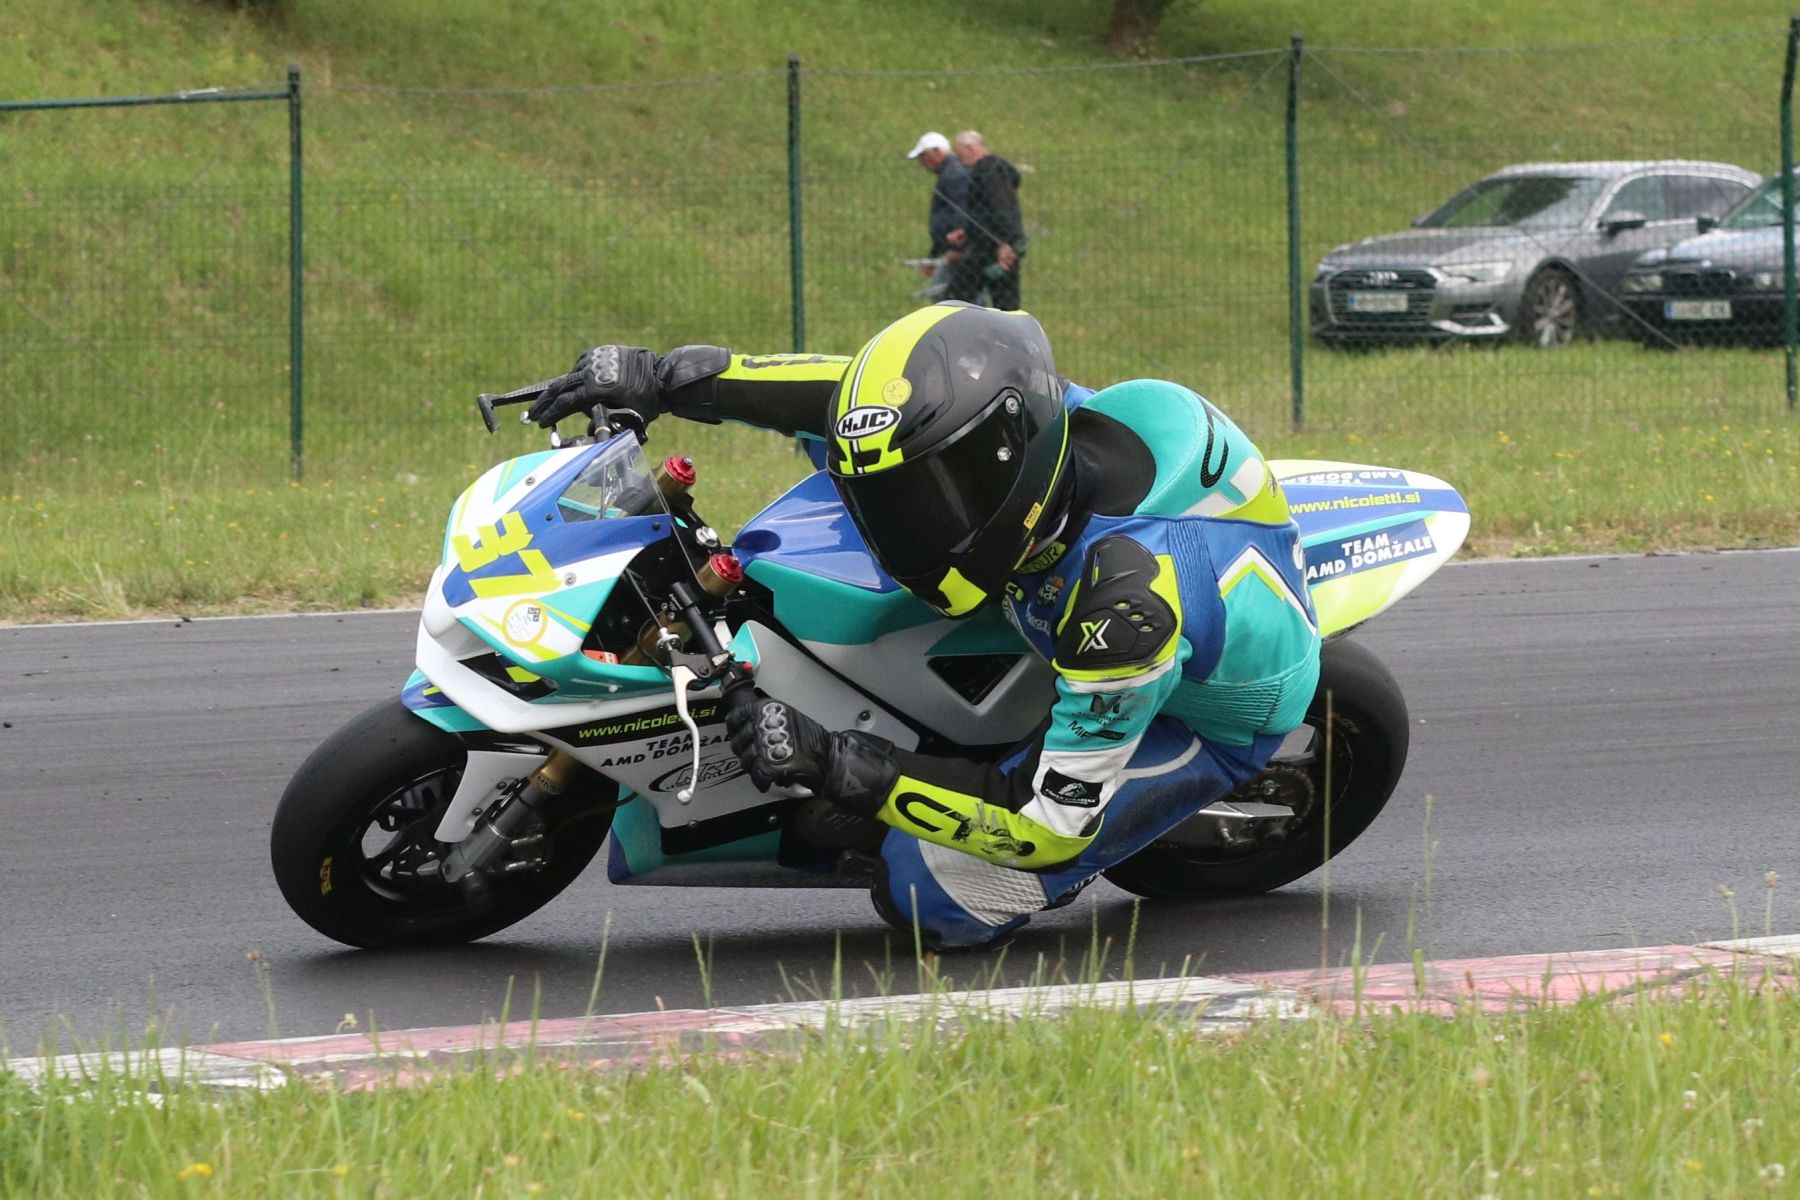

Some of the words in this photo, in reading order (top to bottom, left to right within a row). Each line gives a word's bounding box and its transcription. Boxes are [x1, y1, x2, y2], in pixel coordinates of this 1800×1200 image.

[841, 410, 889, 434] HJC
[1289, 492, 1421, 514] www.nicoletti.si
[452, 510, 562, 599] 37
[1306, 562, 1346, 580] AMD
[1352, 536, 1433, 569] DOMŽALE
[1341, 533, 1391, 557] TEAM
[578, 705, 717, 739] www.nicolei.si
[601, 753, 646, 768] AMD
[652, 735, 732, 760] DOMŽAL
